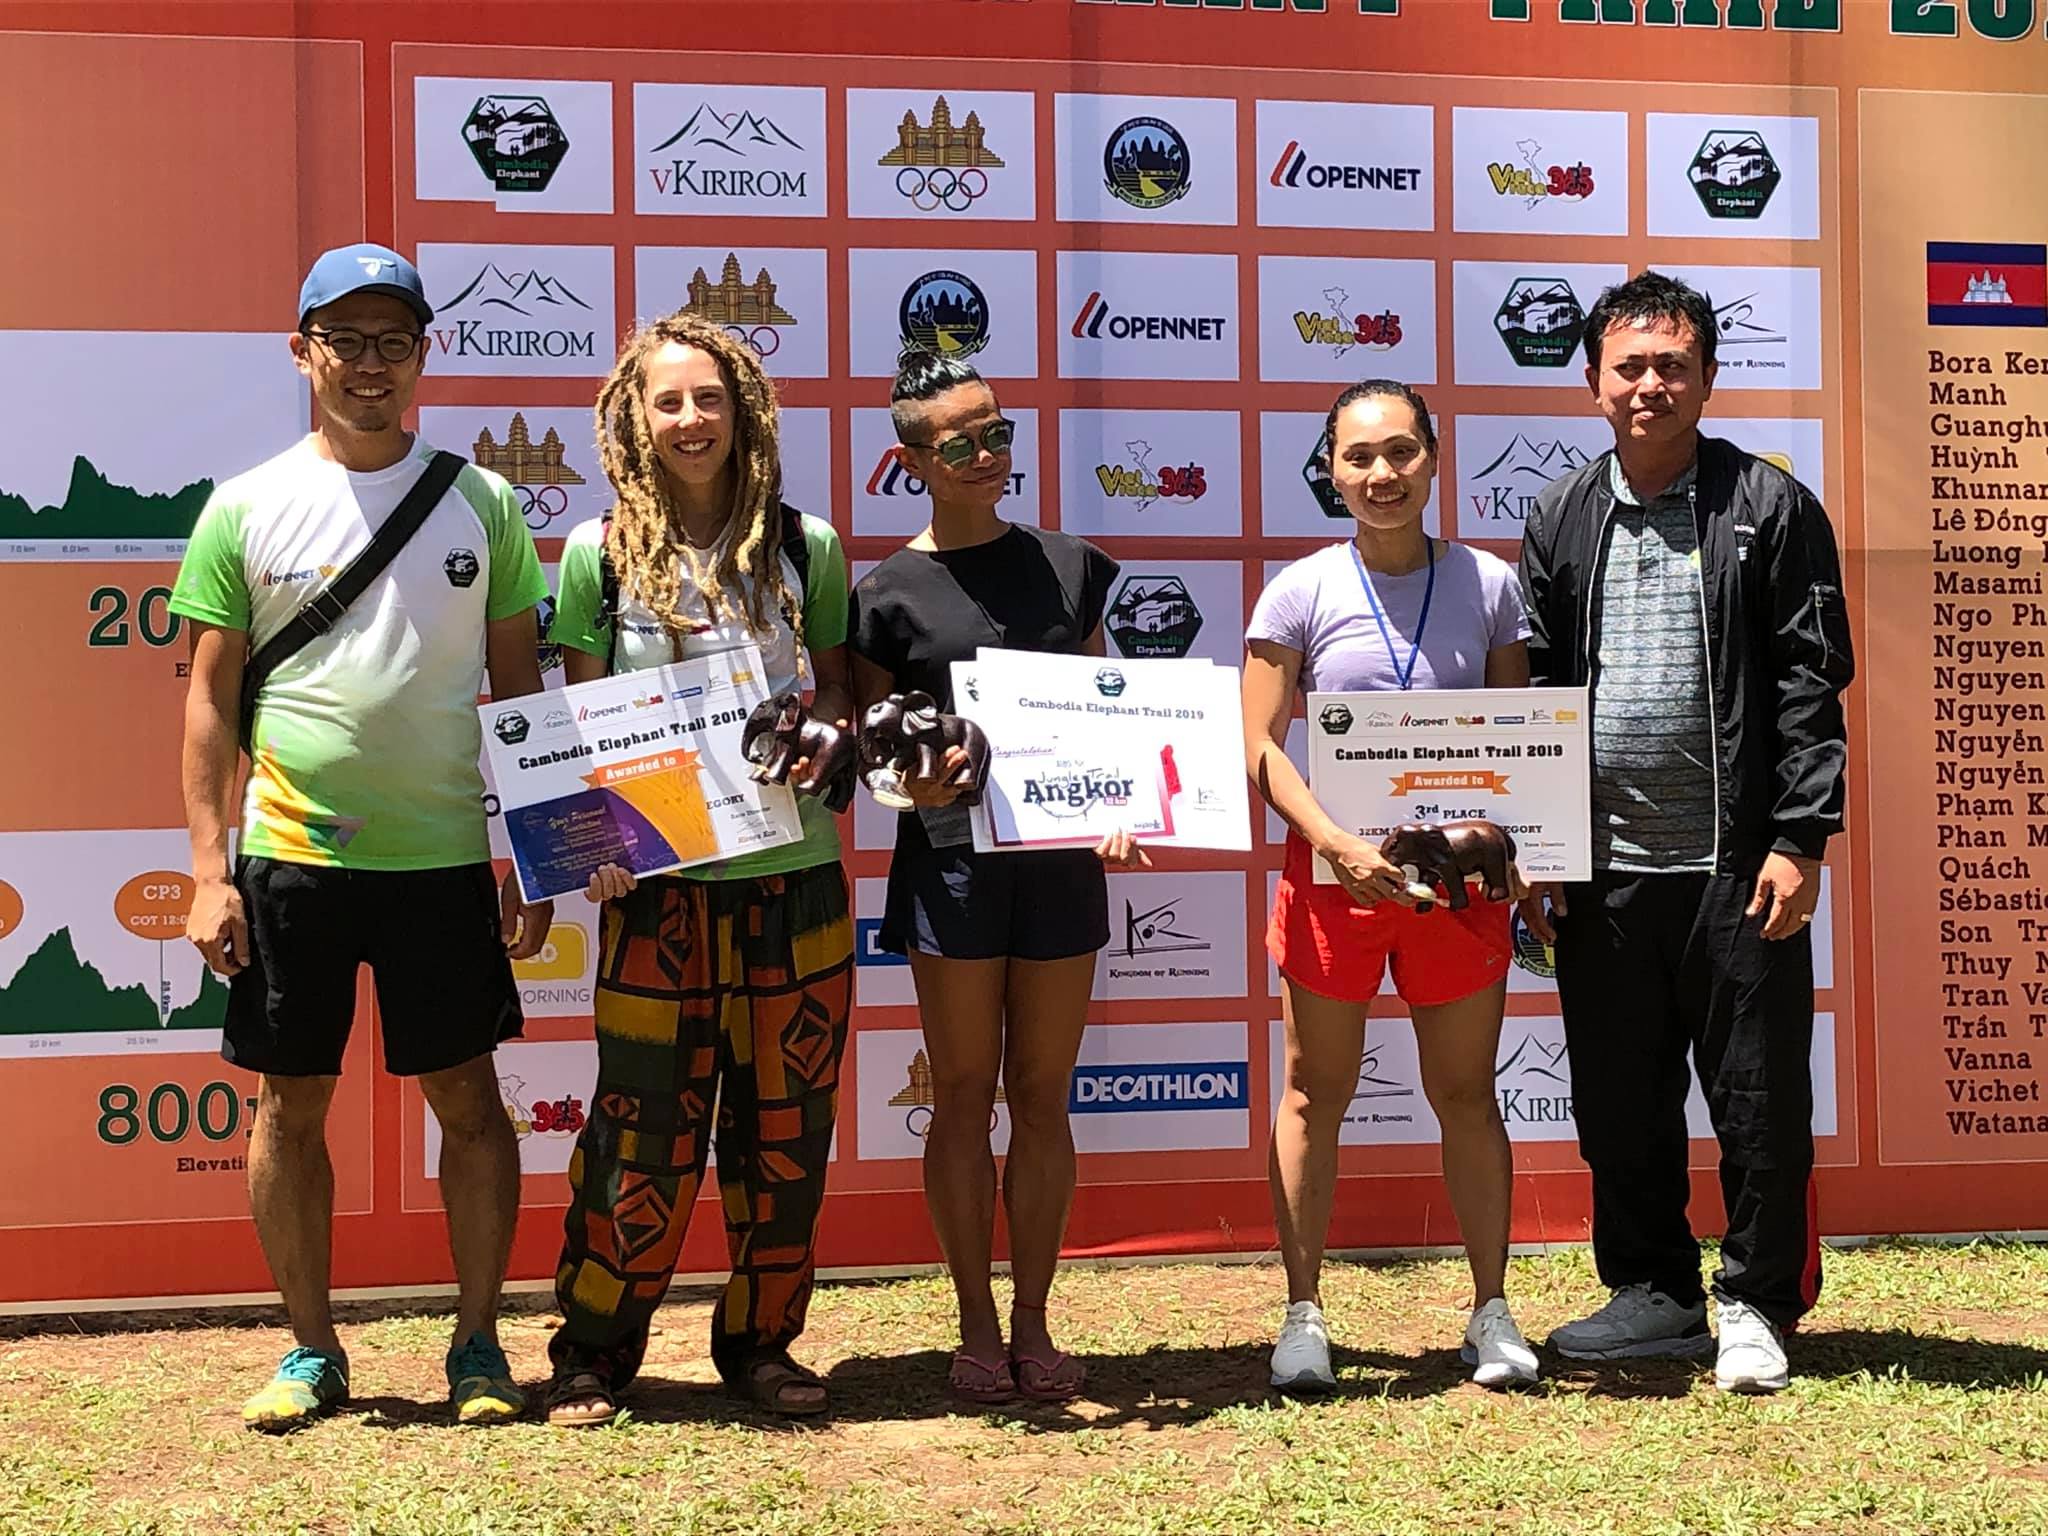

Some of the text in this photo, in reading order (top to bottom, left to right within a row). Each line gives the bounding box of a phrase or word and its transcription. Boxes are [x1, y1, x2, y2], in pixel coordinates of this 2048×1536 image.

[1306, 165, 1421, 191] OPENNET
[1109, 316, 1225, 340] OPENNET
[1928, 351, 1992, 374] Bora
[1929, 382, 2007, 406] Manh
[1931, 445, 2018, 473] Huỳnh
[1932, 508, 1966, 531] Lê
[1933, 540, 2022, 569] Luong
[1934, 571, 2043, 595] Masami
[1934, 603, 1992, 632] Ngo
[1128, 634, 1184, 645] Cambodia
[1934, 635, 2045, 664] Nguyen
[1934, 666, 2045, 696] Nguyen
[1018, 698, 1205, 720] Cambodia Elephant Trail 2019
[1411, 714, 1449, 727] OPENNET
[1935, 698, 2046, 727] Nguyen
[519, 707, 748, 770] Cambodia Elephant Trail 2019
[1935, 729, 2044, 759] Nguyễn
[1335, 744, 1563, 762] Cambodia Elephant Trail 2019
[605, 756, 677, 781] Awarded to
[1936, 760, 2045, 790] Nguyễn
[1023, 775, 1134, 807] Angkor
[1413, 775, 1484, 787] Awarded to
[706, 793, 745, 810] EGORY
[1414, 804, 1486, 820] 3rd PLACE
[1937, 793, 2014, 821] Phạm
[1501, 825, 1543, 835] EGORY
[1938, 825, 2006, 848] Phan
[1939, 856, 2030, 883] Quách
[143, 884, 181, 900] CP3
[1940, 888, 2048, 911] Sébasti
[130, 915, 158, 926] COT
[1941, 920, 1992, 943] Son
[1942, 952, 2012, 981] Thuy
[518, 988, 590, 1004] ORNING
[1943, 984, 2009, 1007] Tran
[1944, 1047, 2032, 1071] Vanna
[1076, 1072, 1239, 1103] DECATHLON
[1945, 1079, 2039, 1102] Vichet
[1946, 1111, 2048, 1135] Watana
